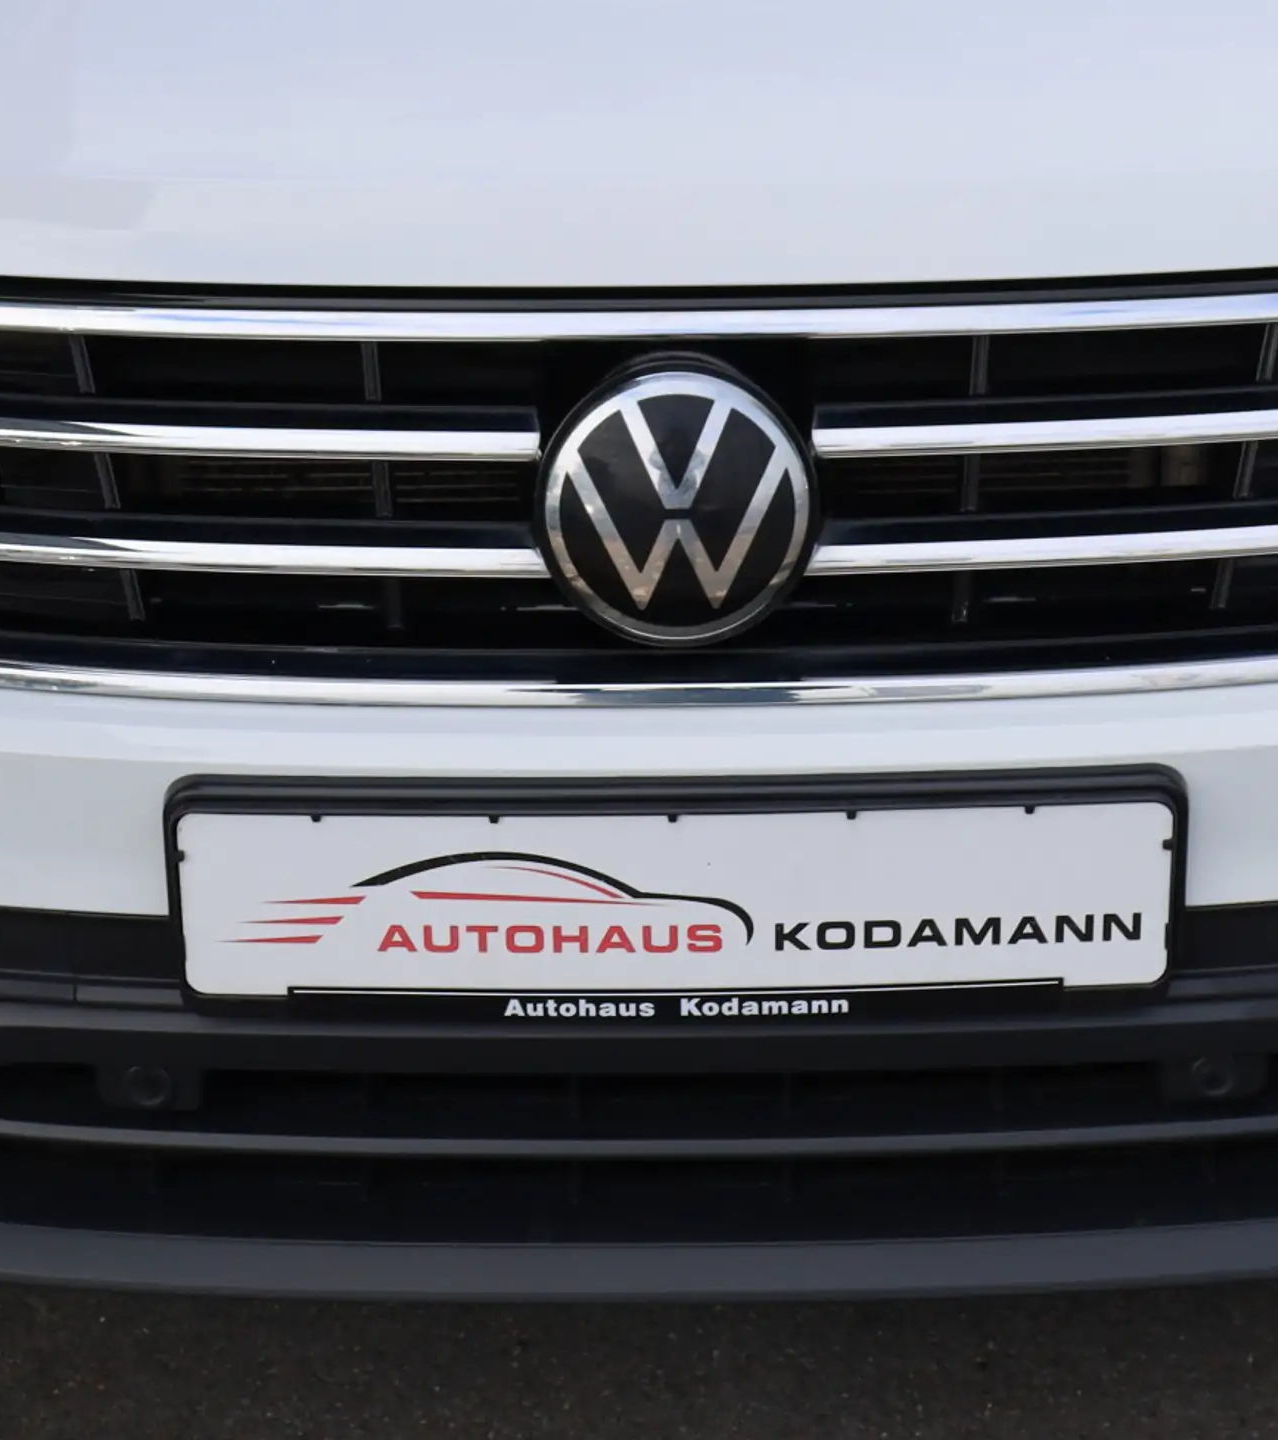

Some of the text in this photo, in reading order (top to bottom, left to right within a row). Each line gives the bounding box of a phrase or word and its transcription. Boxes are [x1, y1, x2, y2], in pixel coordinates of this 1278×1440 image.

[379, 912, 1143, 954] AUTOHAUS KODAMANN
[503, 997, 850, 1018] Autohaus Kodamann
